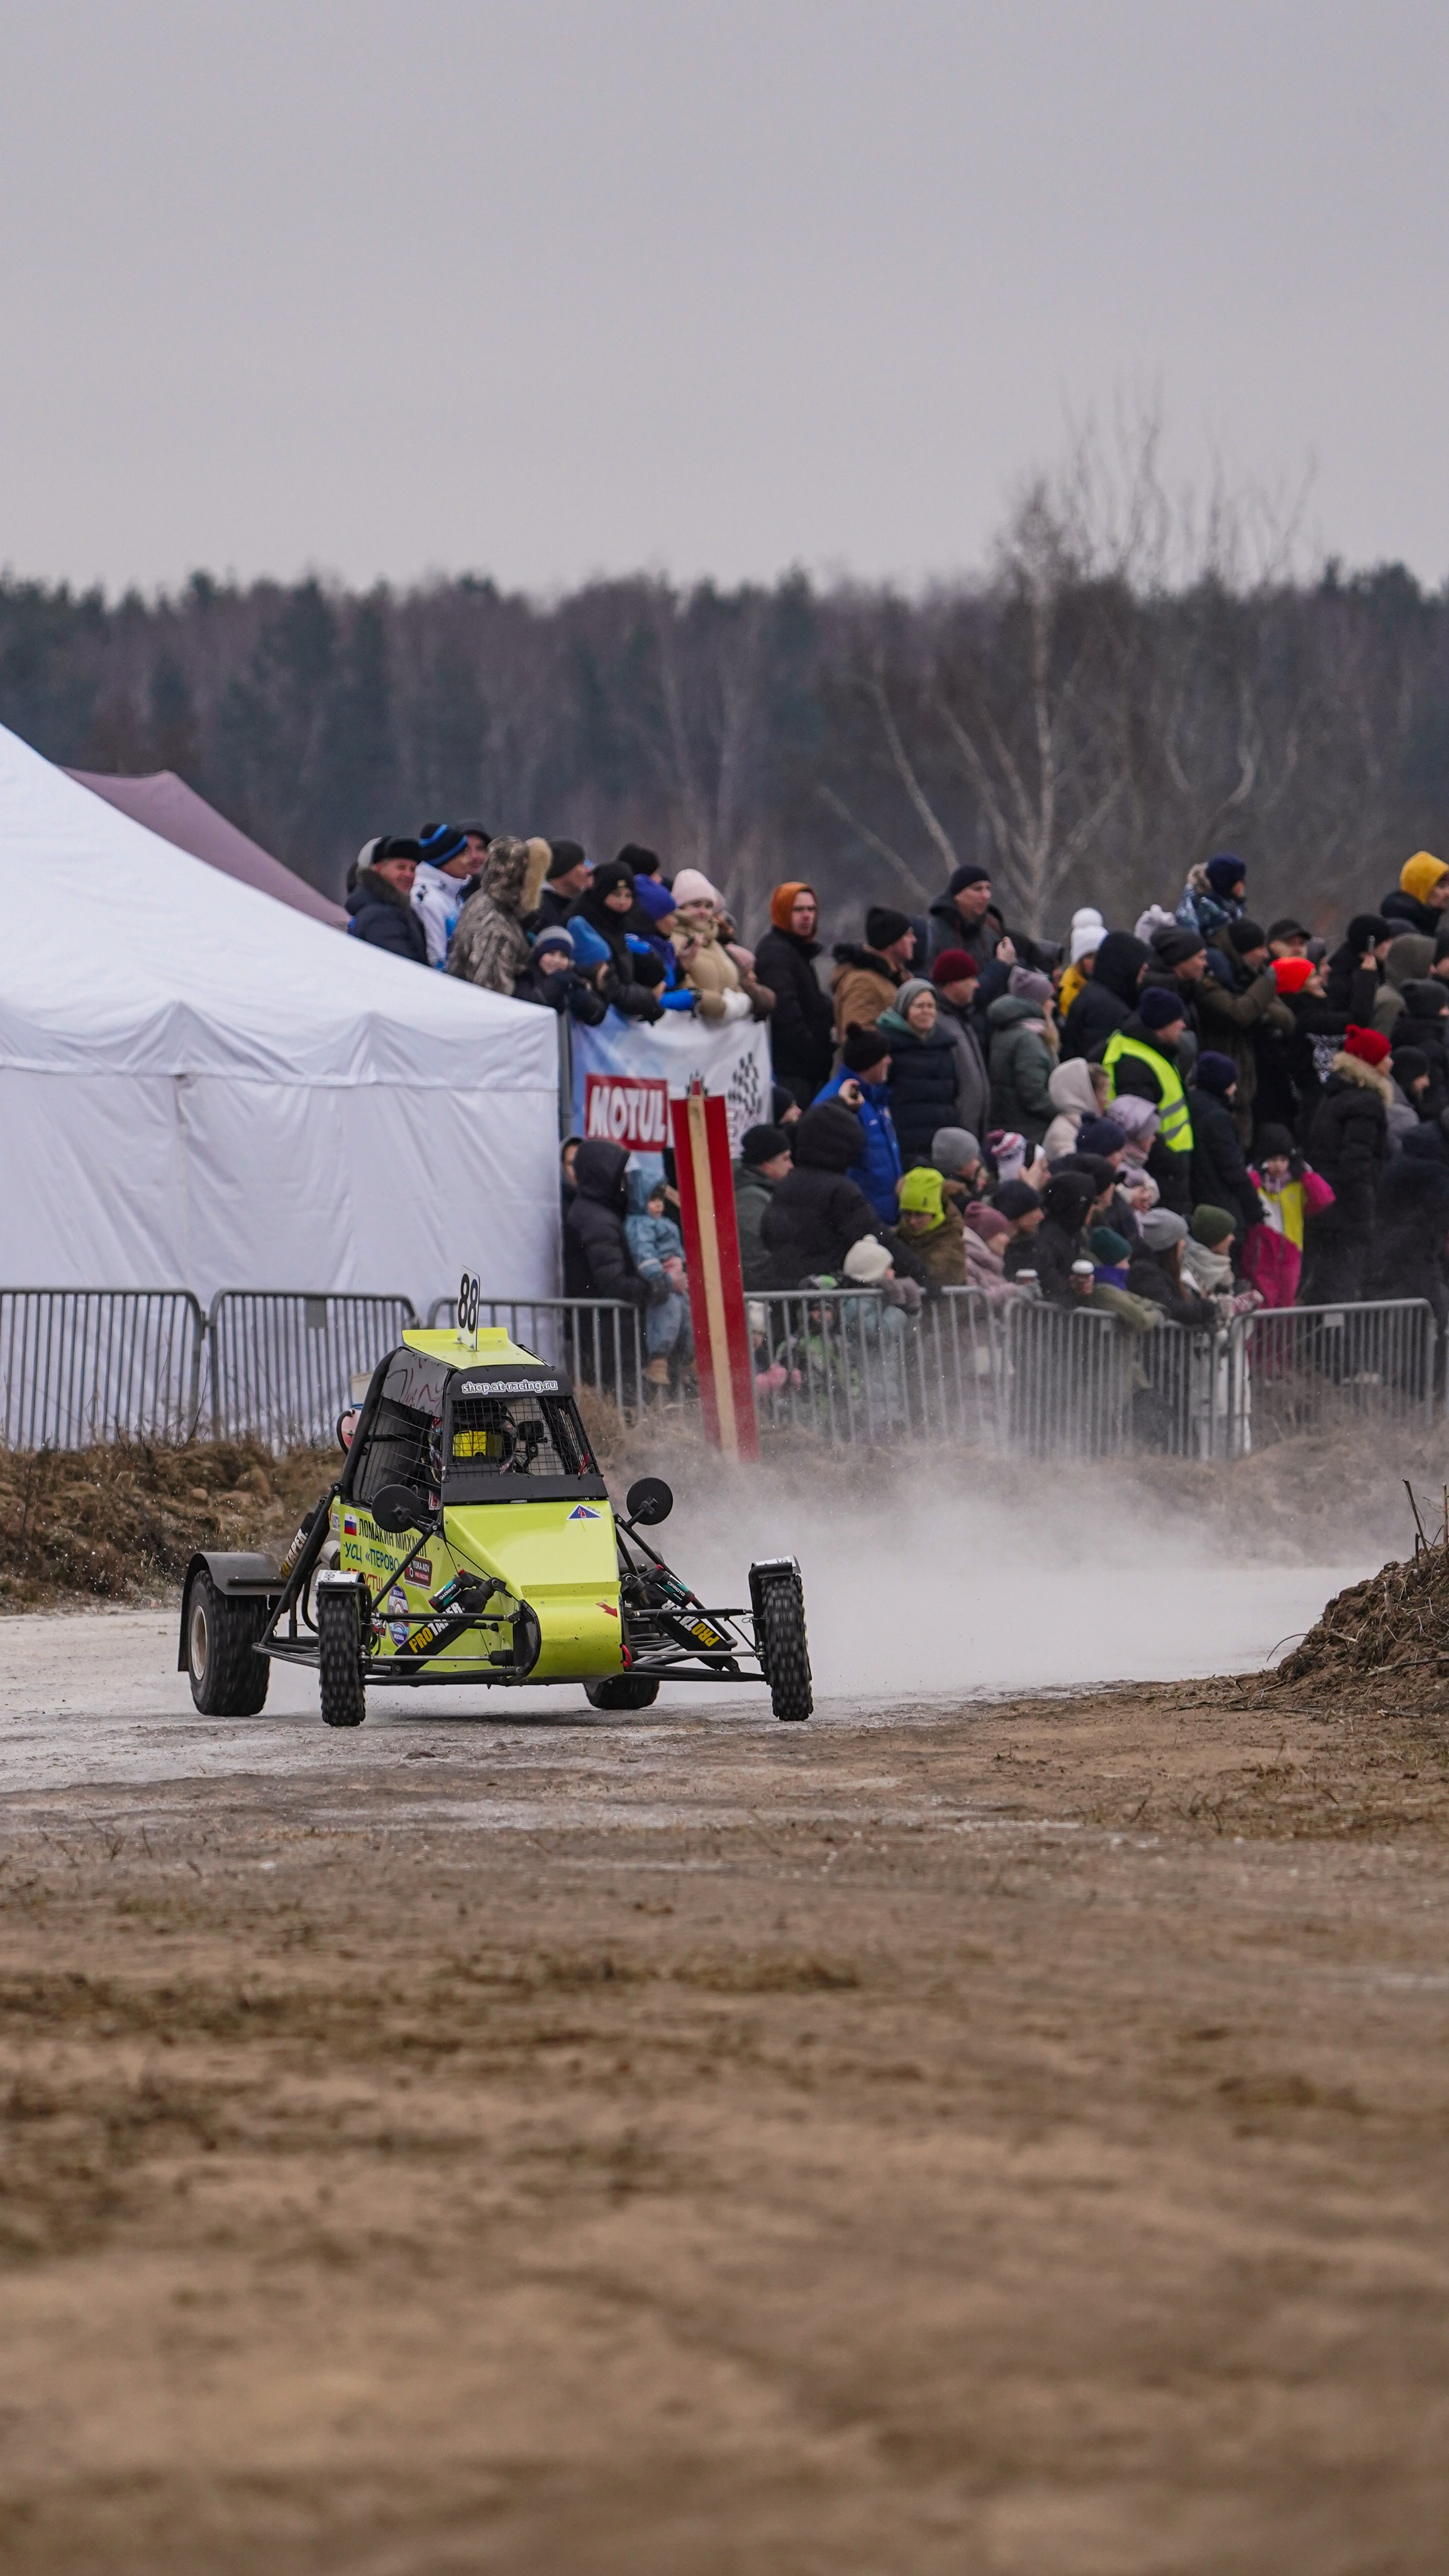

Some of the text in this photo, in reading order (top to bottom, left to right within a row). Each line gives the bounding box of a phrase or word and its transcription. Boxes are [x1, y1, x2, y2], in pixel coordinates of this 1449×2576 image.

[588, 1085, 667, 1143] MOTUL
[458, 1273, 479, 1334] 88
[462, 1379, 558, 1394] shop.at-racing.ru
[358, 1518, 394, 1547] ЛОМАКИН
[345, 1541, 401, 1572] УСЦ «ПЕРОВО
[408, 1602, 464, 1654] PROTAER
